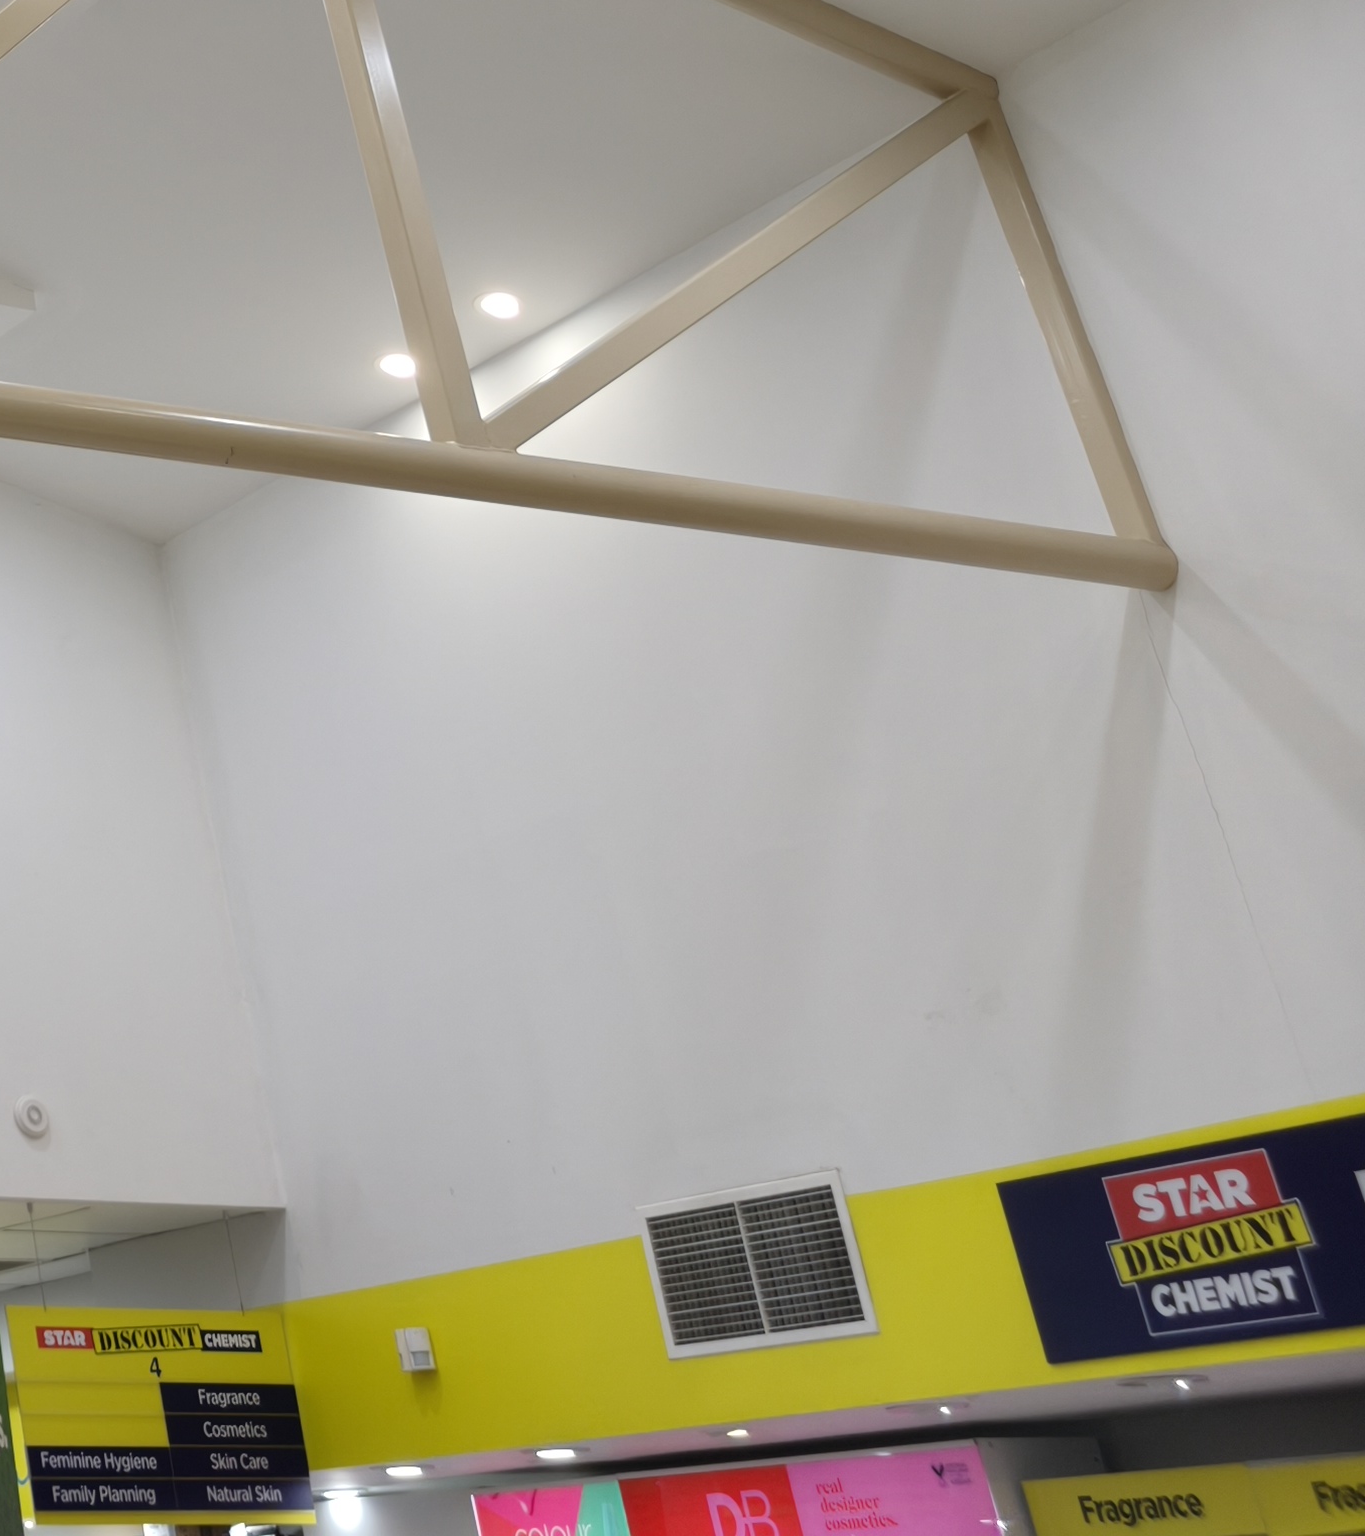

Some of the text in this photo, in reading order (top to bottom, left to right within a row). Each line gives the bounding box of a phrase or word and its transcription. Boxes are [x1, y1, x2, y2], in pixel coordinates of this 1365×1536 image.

[1132, 1168, 1256, 1222] STAR
[1120, 1208, 1299, 1278] DISCOUNT
[1151, 1265, 1298, 1318] CHEMIST
[44, 1326, 258, 1351] STAR DISCOUNT CHEMIST
[150, 1357, 162, 1378] 4
[198, 1389, 261, 1407] Fragrance
[203, 1422, 267, 1439] Cosmetics
[40, 1451, 158, 1472] Feminine Hygiene
[209, 1454, 269, 1470] Skin Care
[52, 1486, 157, 1505] Family Planning
[207, 1486, 282, 1503] Natural Skin
[815, 1478, 844, 1495] real
[819, 1497, 880, 1514] designer
[1077, 1493, 1205, 1527] Fragrance
